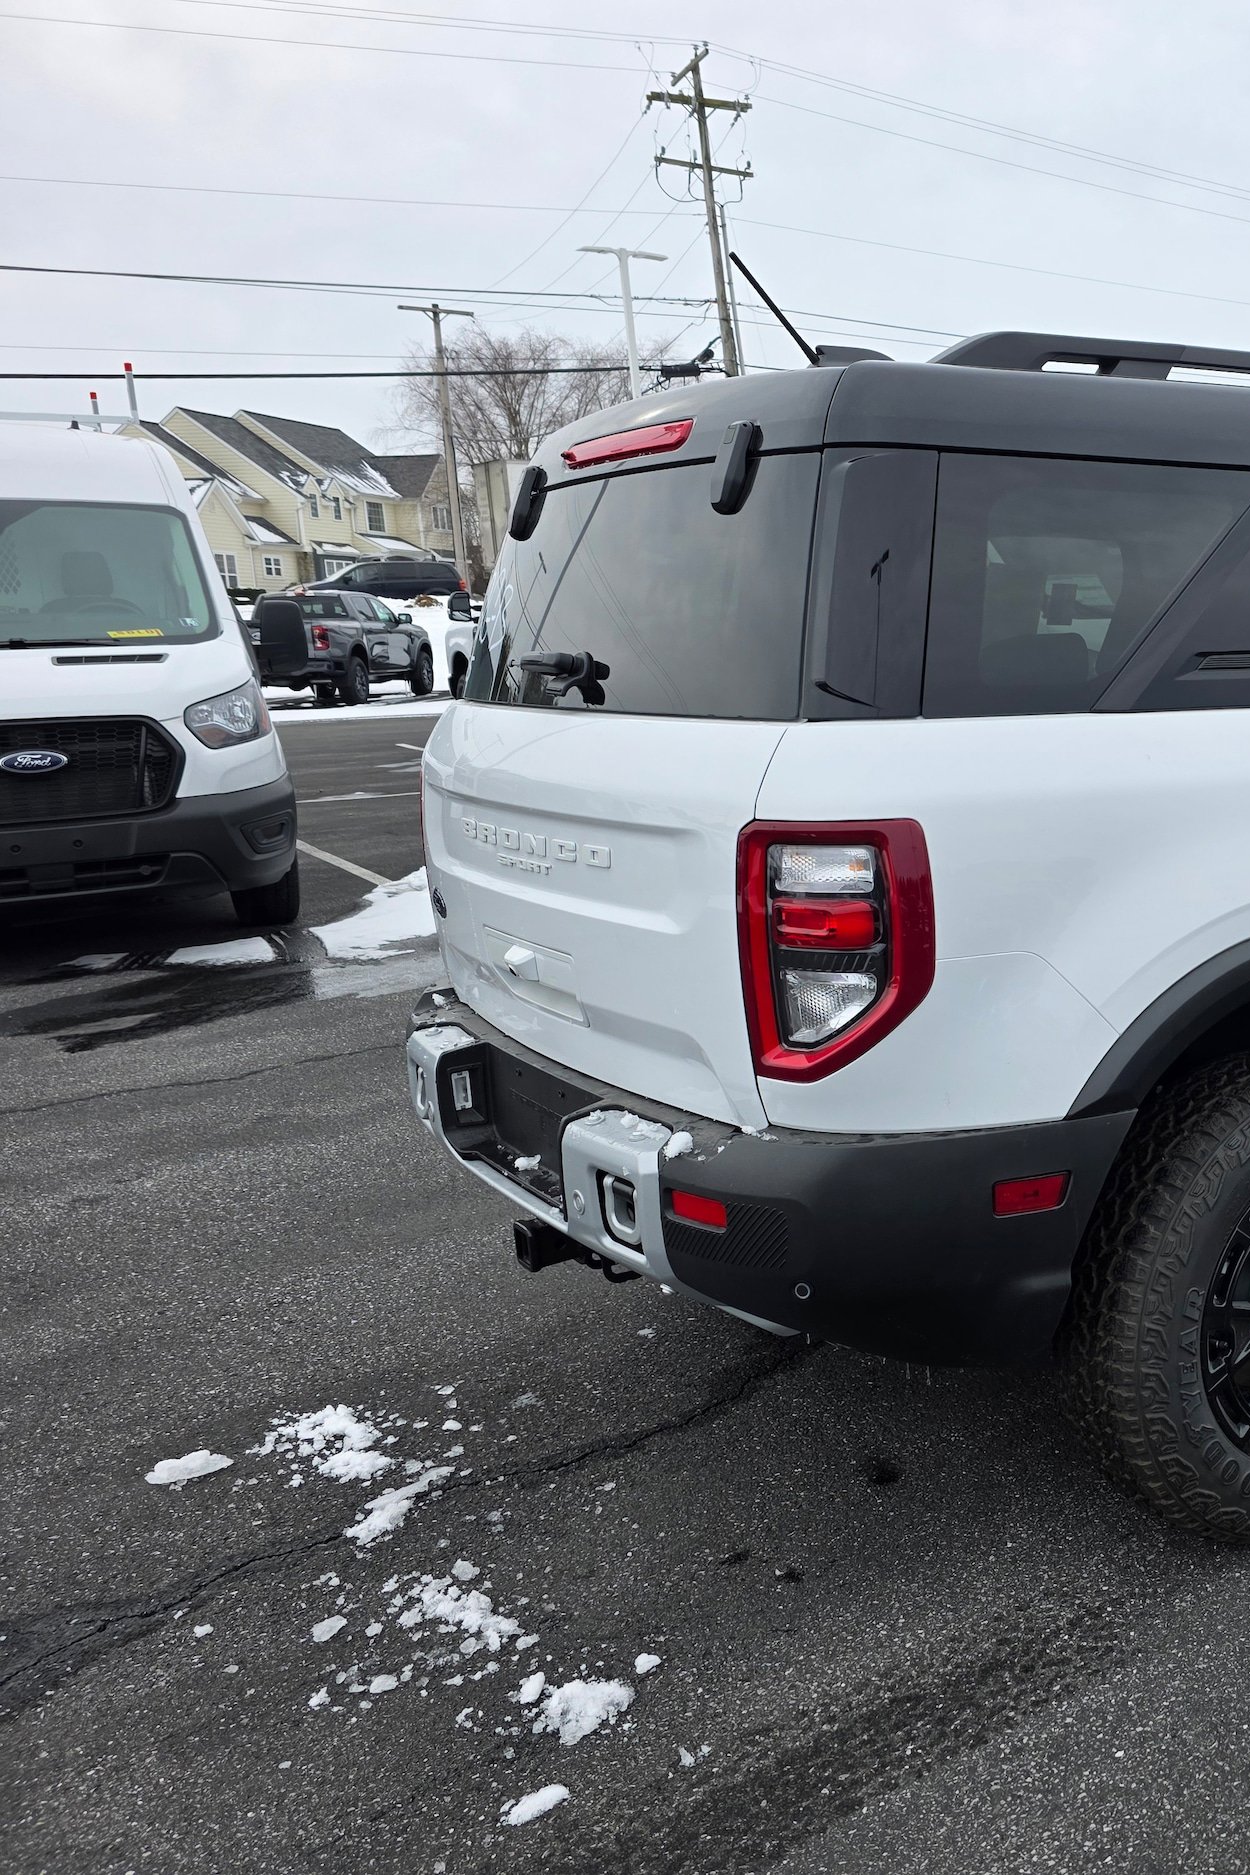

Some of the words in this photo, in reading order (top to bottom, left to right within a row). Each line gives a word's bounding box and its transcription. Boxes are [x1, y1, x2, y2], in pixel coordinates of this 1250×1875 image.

[14, 753, 52, 769] Ford
[460, 817, 612, 869] BRONCO
[496, 852, 553, 876] SPORT
